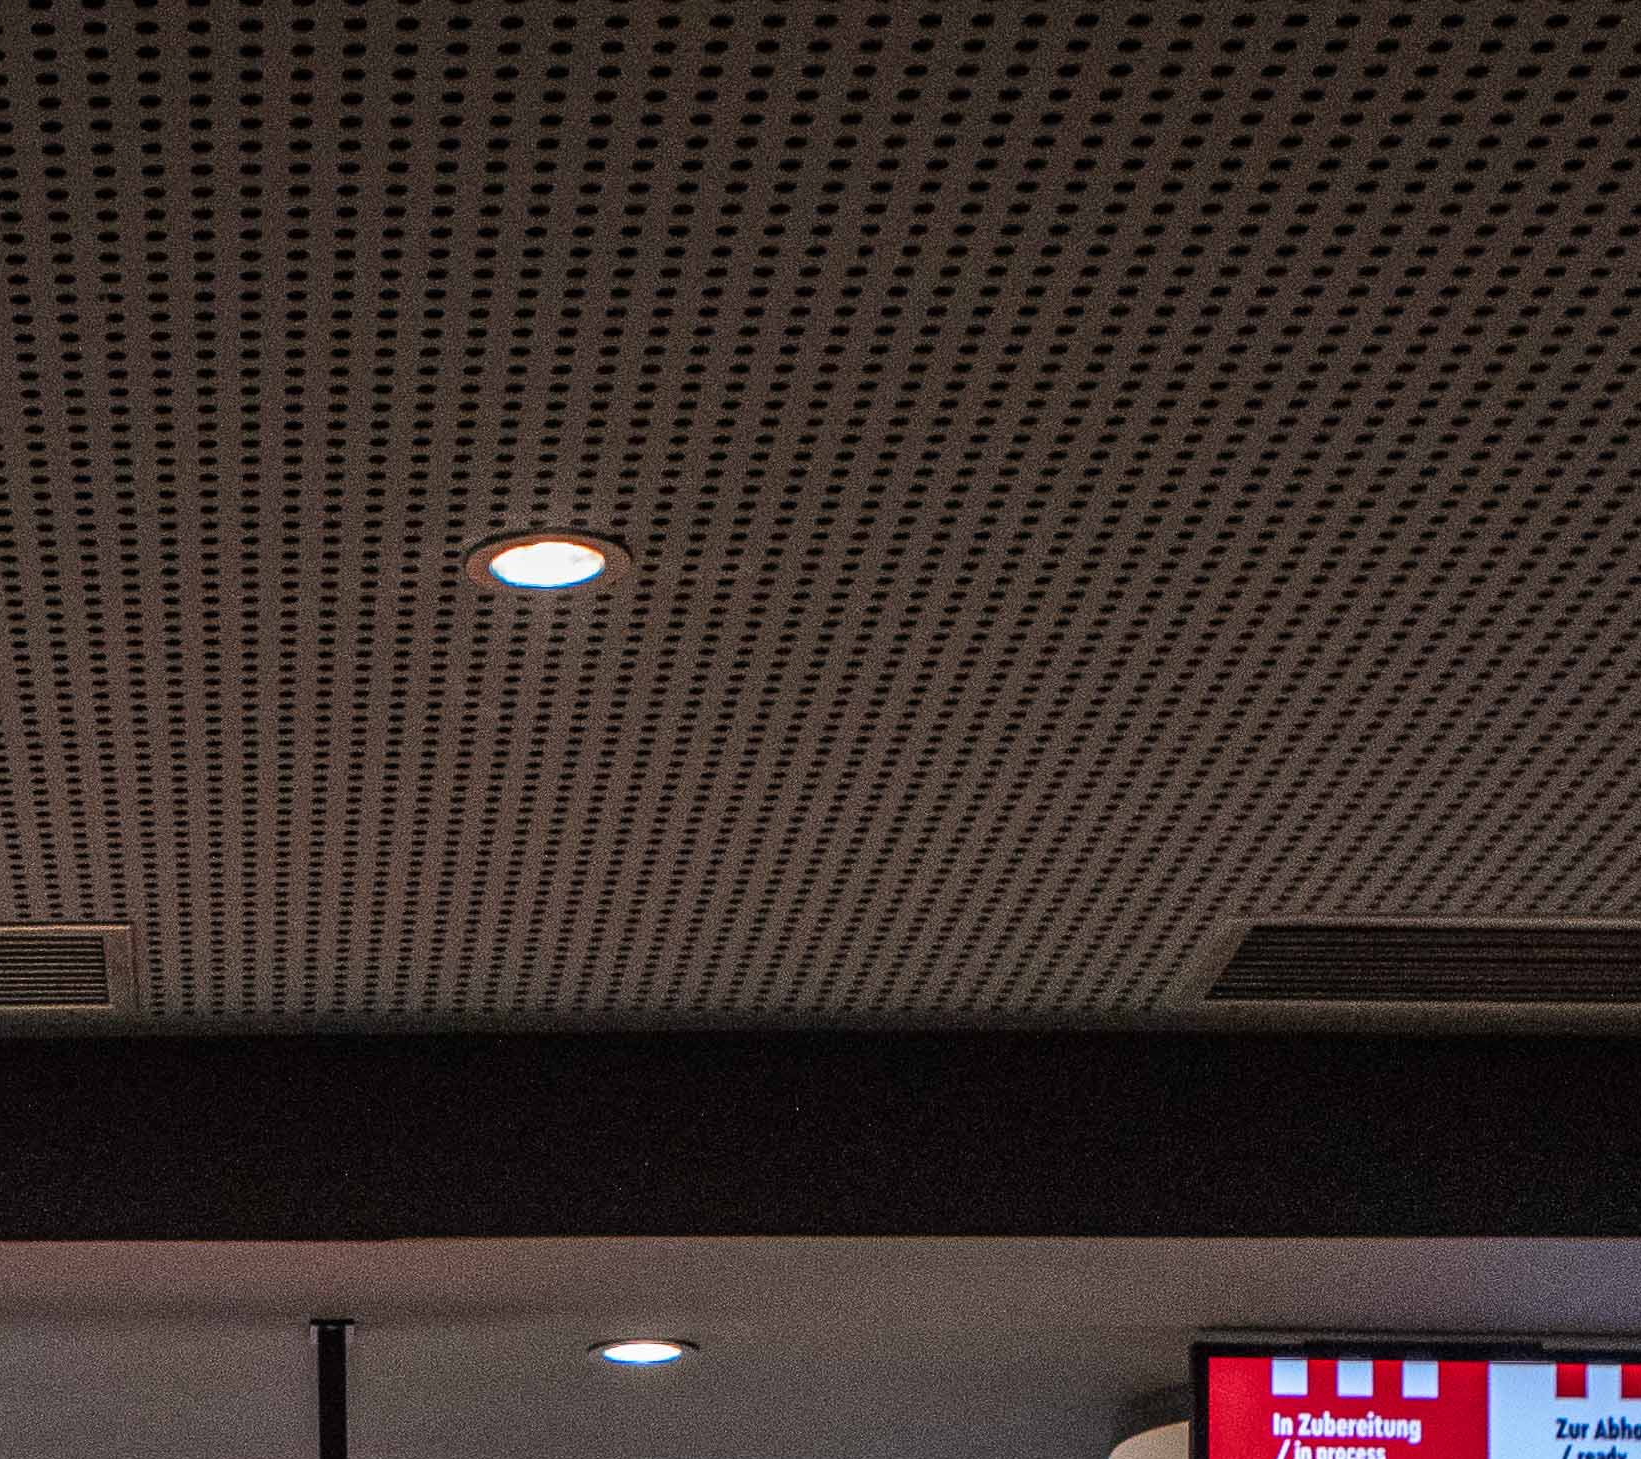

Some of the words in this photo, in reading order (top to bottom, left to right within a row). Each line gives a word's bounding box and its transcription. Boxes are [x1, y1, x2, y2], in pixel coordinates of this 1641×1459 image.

[1272, 1412, 1294, 1437] In
[1297, 1411, 1422, 1444] Zubereitung
[1555, 1417, 1591, 1440] Zur
